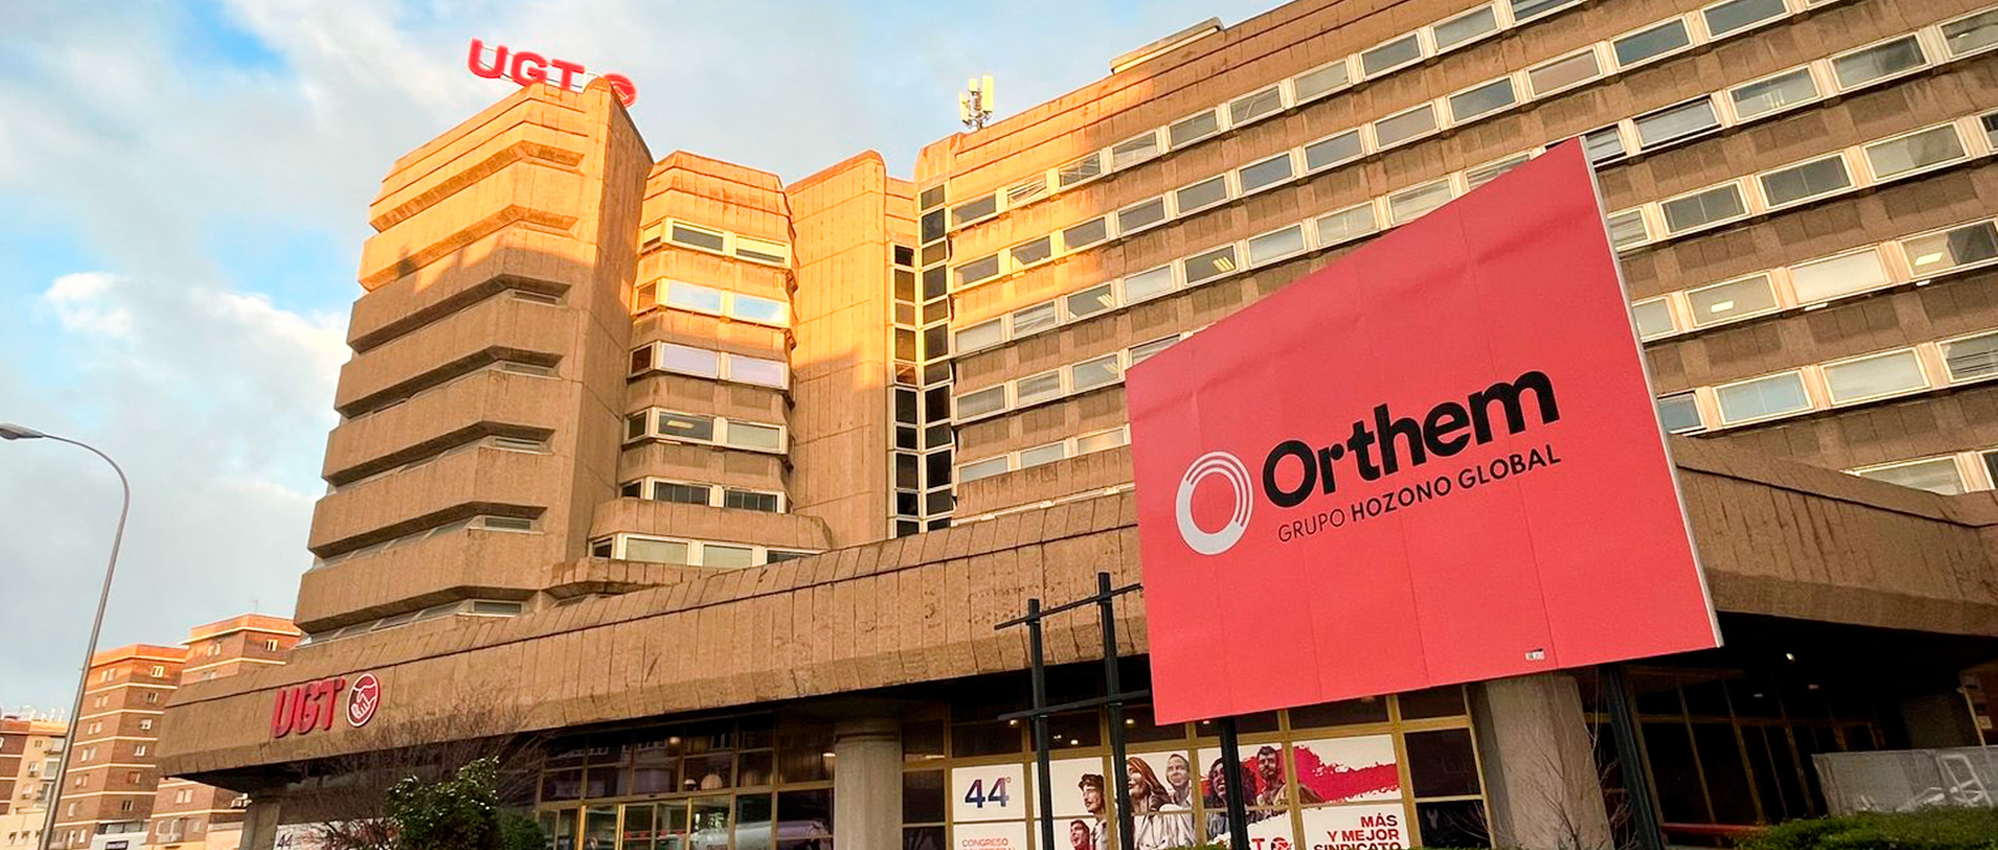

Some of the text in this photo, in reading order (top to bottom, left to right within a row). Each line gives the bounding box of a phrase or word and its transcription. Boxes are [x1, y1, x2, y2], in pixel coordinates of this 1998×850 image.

[468, 38, 585, 90] UGT
[1262, 371, 1560, 507] Orthem
[1278, 444, 1561, 542] GRUPO HOZONO GLOBAL
[271, 677, 345, 738] UGT
[1327, 829, 1399, 842] Y MEJOR
[1360, 813, 1397, 827] MÁS
